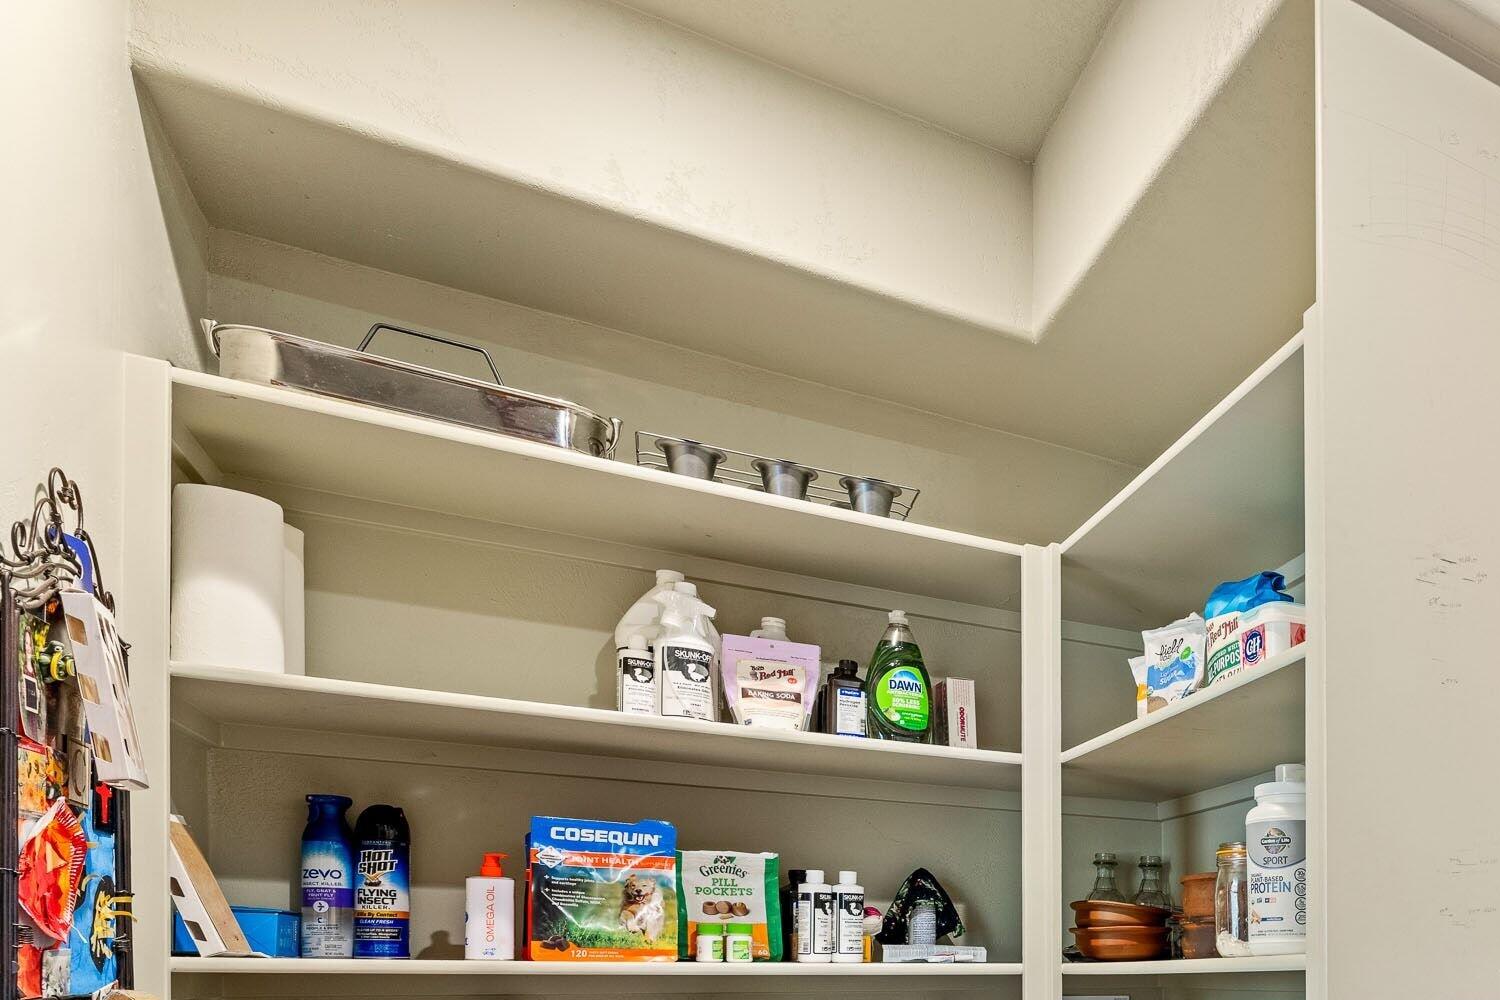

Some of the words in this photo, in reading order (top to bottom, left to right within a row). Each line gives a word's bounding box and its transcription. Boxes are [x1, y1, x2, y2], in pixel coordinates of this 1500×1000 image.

[1210, 625, 1222, 647] Red
[1222, 617, 1239, 640] Mill
[759, 670, 776, 681] Red
[777, 669, 794, 679] Mill
[889, 679, 922, 693] DAWN
[748, 690, 775, 698] BAKING
[776, 692, 796, 700] SODA
[959, 706, 967, 742] ODORMUTE
[550, 826, 659, 847] COSEQUIN
[359, 849, 393, 862] HOT
[601, 856, 639, 866] HEALTH
[1263, 855, 1289, 866] SPORT
[357, 860, 398, 875] SHOT
[699, 864, 748, 879] Greenies
[303, 868, 342, 880] zevo
[712, 878, 738, 887] PILL
[1250, 881, 1292, 895] PROTEIN
[357, 888, 397, 898] FLYING
[486, 885, 495, 902] OIL
[694, 886, 753, 897] POCKETS
[357, 897, 397, 906] INSECT
[486, 903, 495, 943] OMEGA
[571, 950, 588, 958] 120
